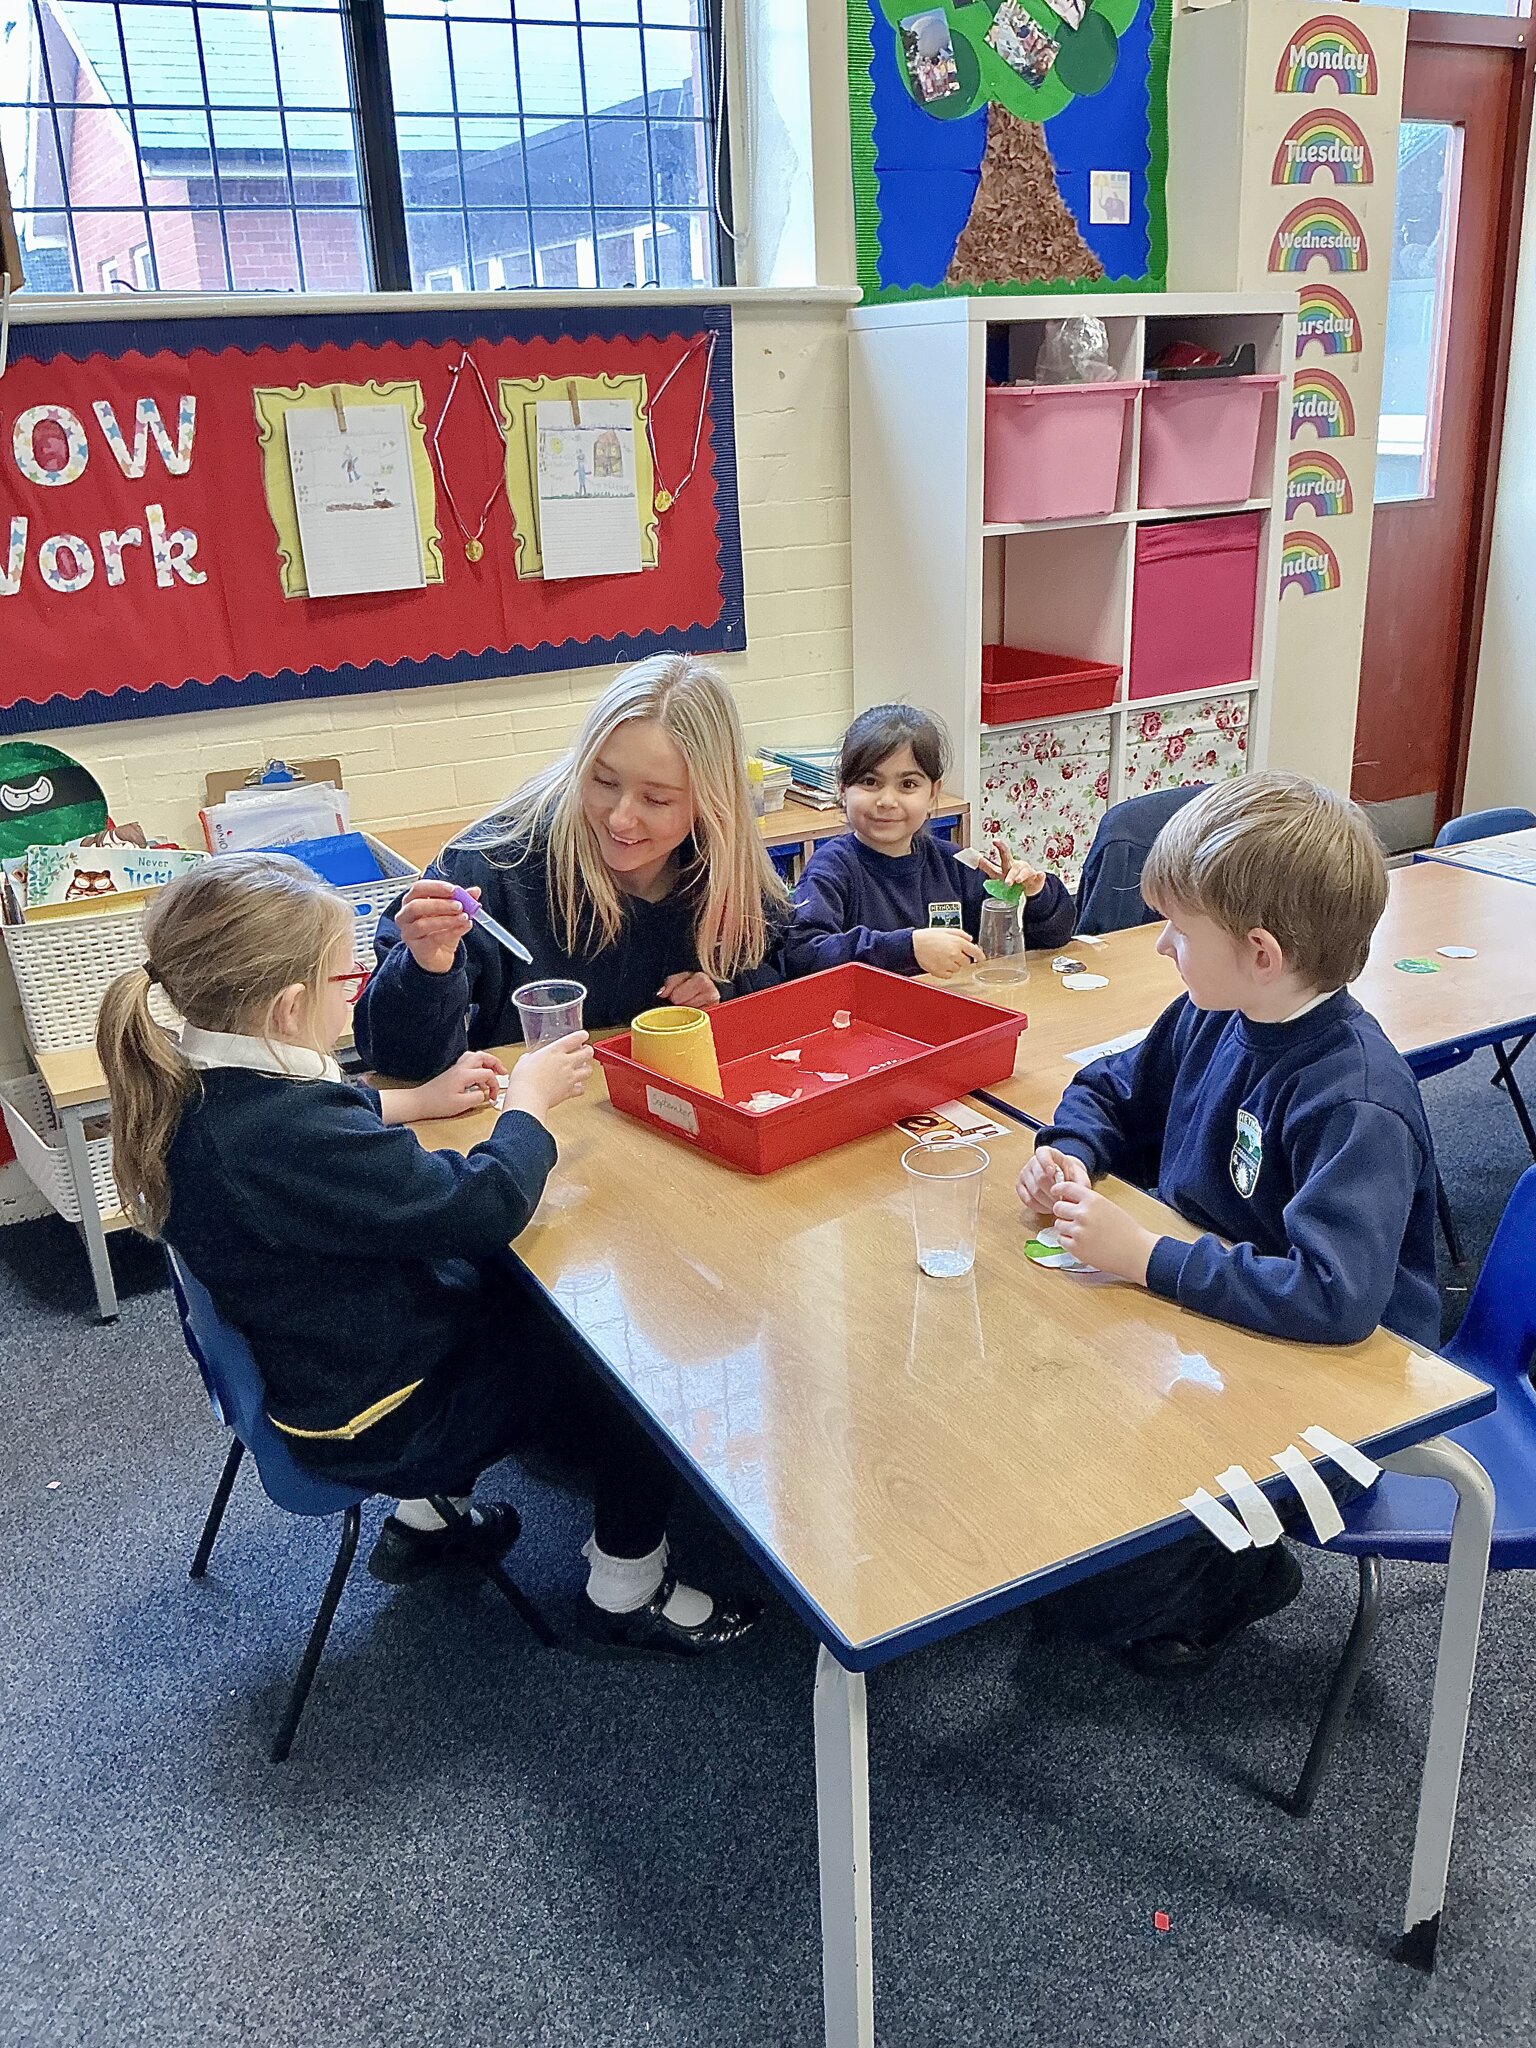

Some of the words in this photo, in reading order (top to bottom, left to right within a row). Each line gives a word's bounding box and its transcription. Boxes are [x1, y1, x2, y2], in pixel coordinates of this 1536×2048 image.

[1289, 45, 1368, 77] Monday
[1285, 138, 1364, 169] Tuesday
[1279, 231, 1360, 254] Wednesday
[1297, 313, 1353, 337] ursday
[1292, 394, 1340, 422] riday
[13, 395, 196, 487] OW
[1286, 475, 1346, 498] turday
[0, 504, 208, 596] ork
[1280, 551, 1329, 577] nday
[215, 823, 229, 850] Olivia
[138, 857, 169, 868] Never
